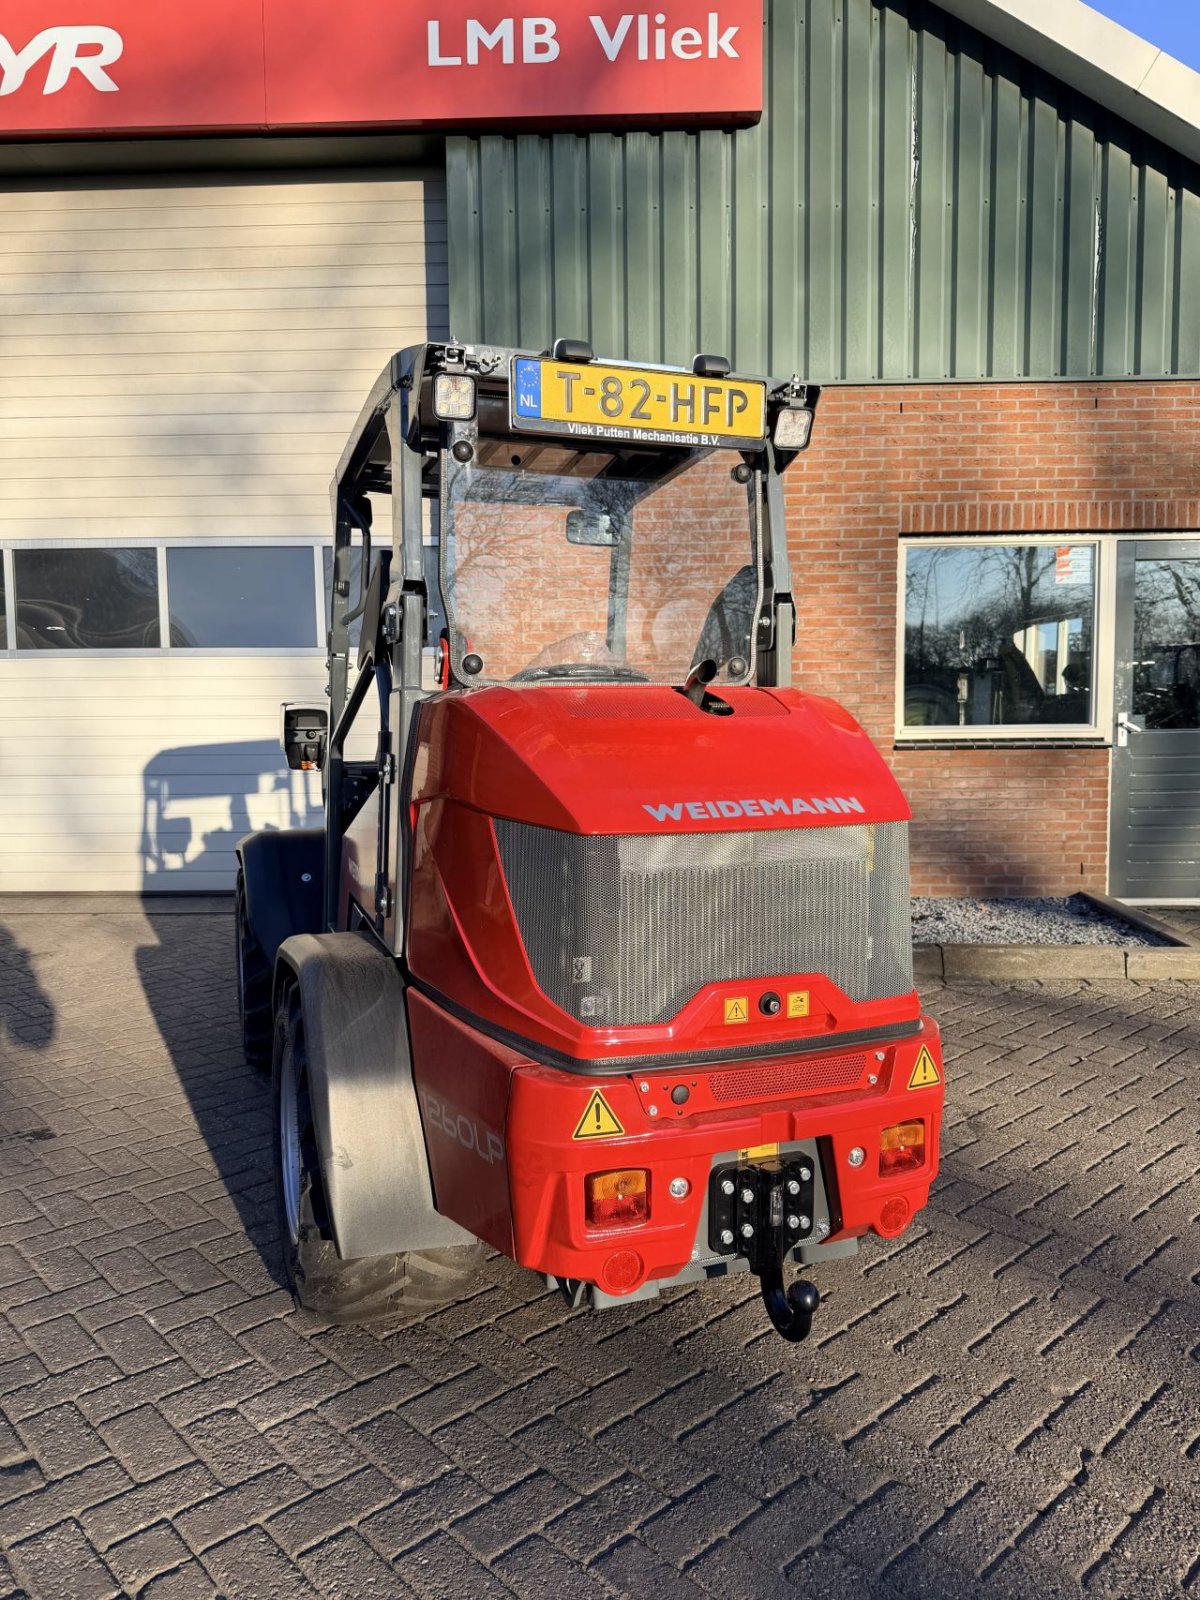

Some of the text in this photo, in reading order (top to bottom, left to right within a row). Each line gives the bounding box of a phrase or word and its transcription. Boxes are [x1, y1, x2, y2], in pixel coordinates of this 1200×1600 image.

[427, 12, 740, 66] LMB Vliek
[519, 394, 538, 409] NL
[556, 370, 749, 427] T-82-HFP
[567, 423, 720, 446] Vliek Putten Mechanisatie B.V.
[642, 797, 865, 822] WEIDEMANN
